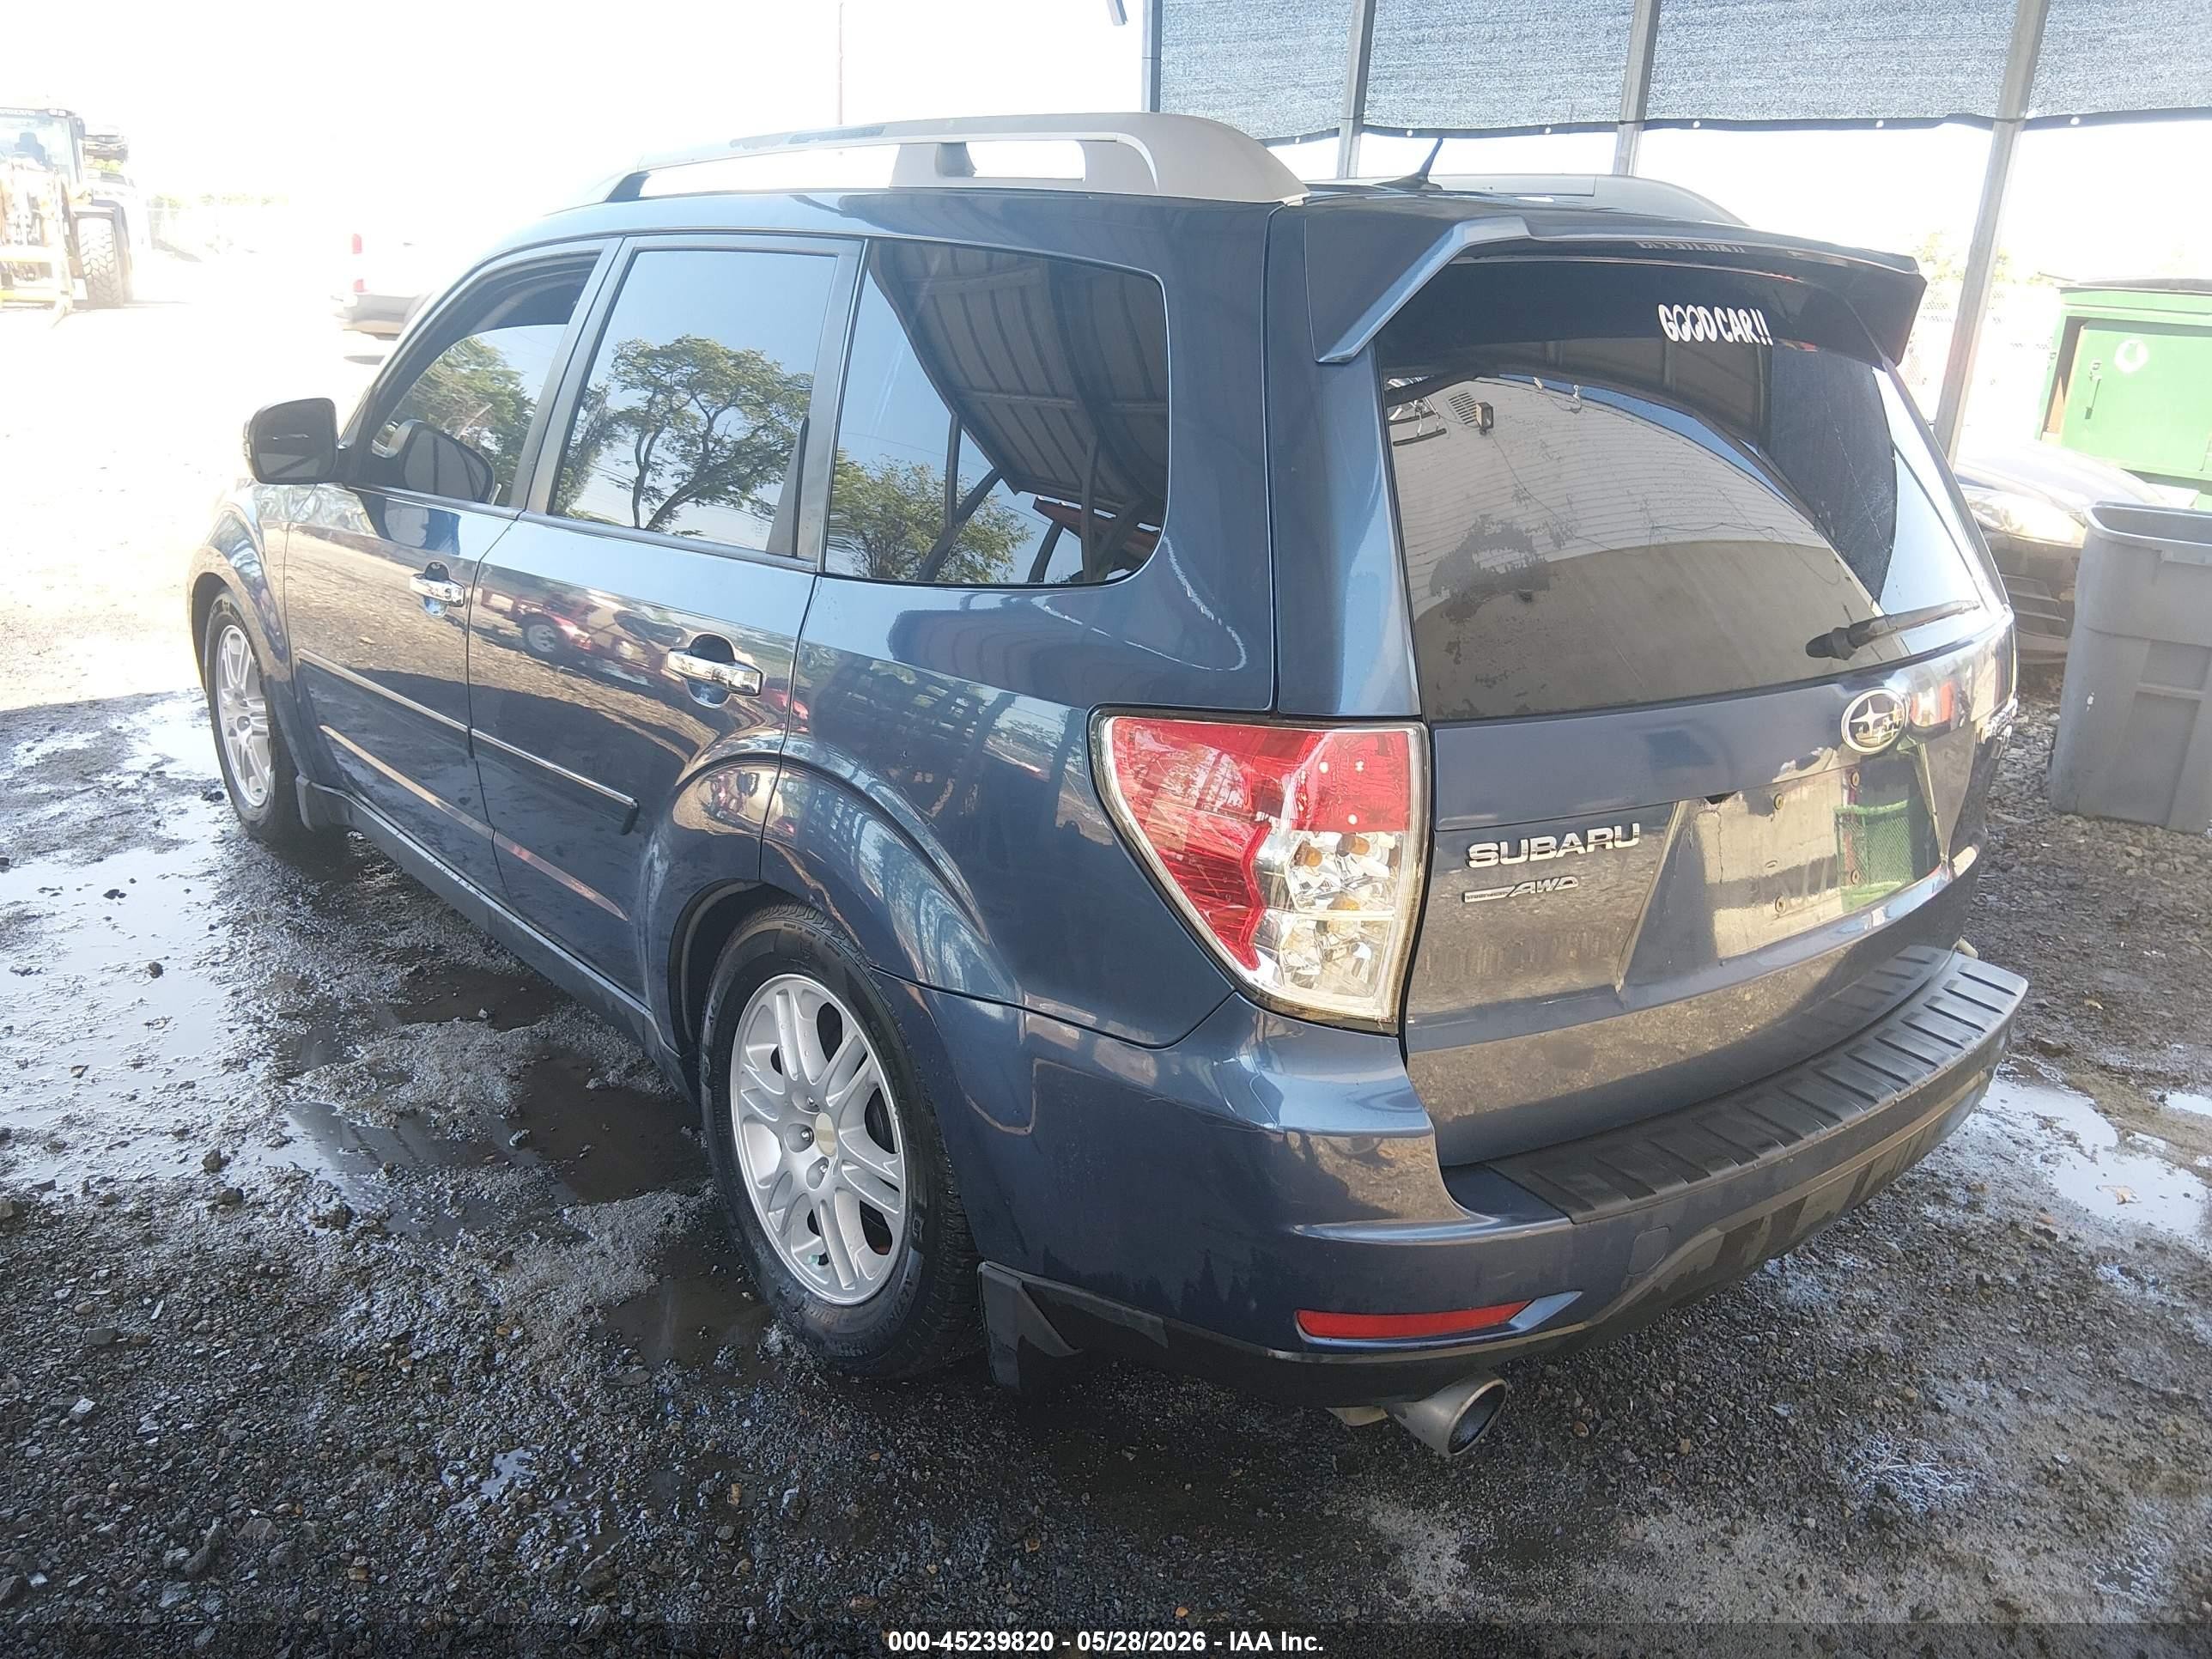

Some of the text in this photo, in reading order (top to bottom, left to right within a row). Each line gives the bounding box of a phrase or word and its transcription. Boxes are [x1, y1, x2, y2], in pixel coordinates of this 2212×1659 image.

[1657, 303, 1774, 346] GOOD CAR!!
[1468, 823, 1641, 868] SUBARU
[1509, 875, 1579, 897] AWD
